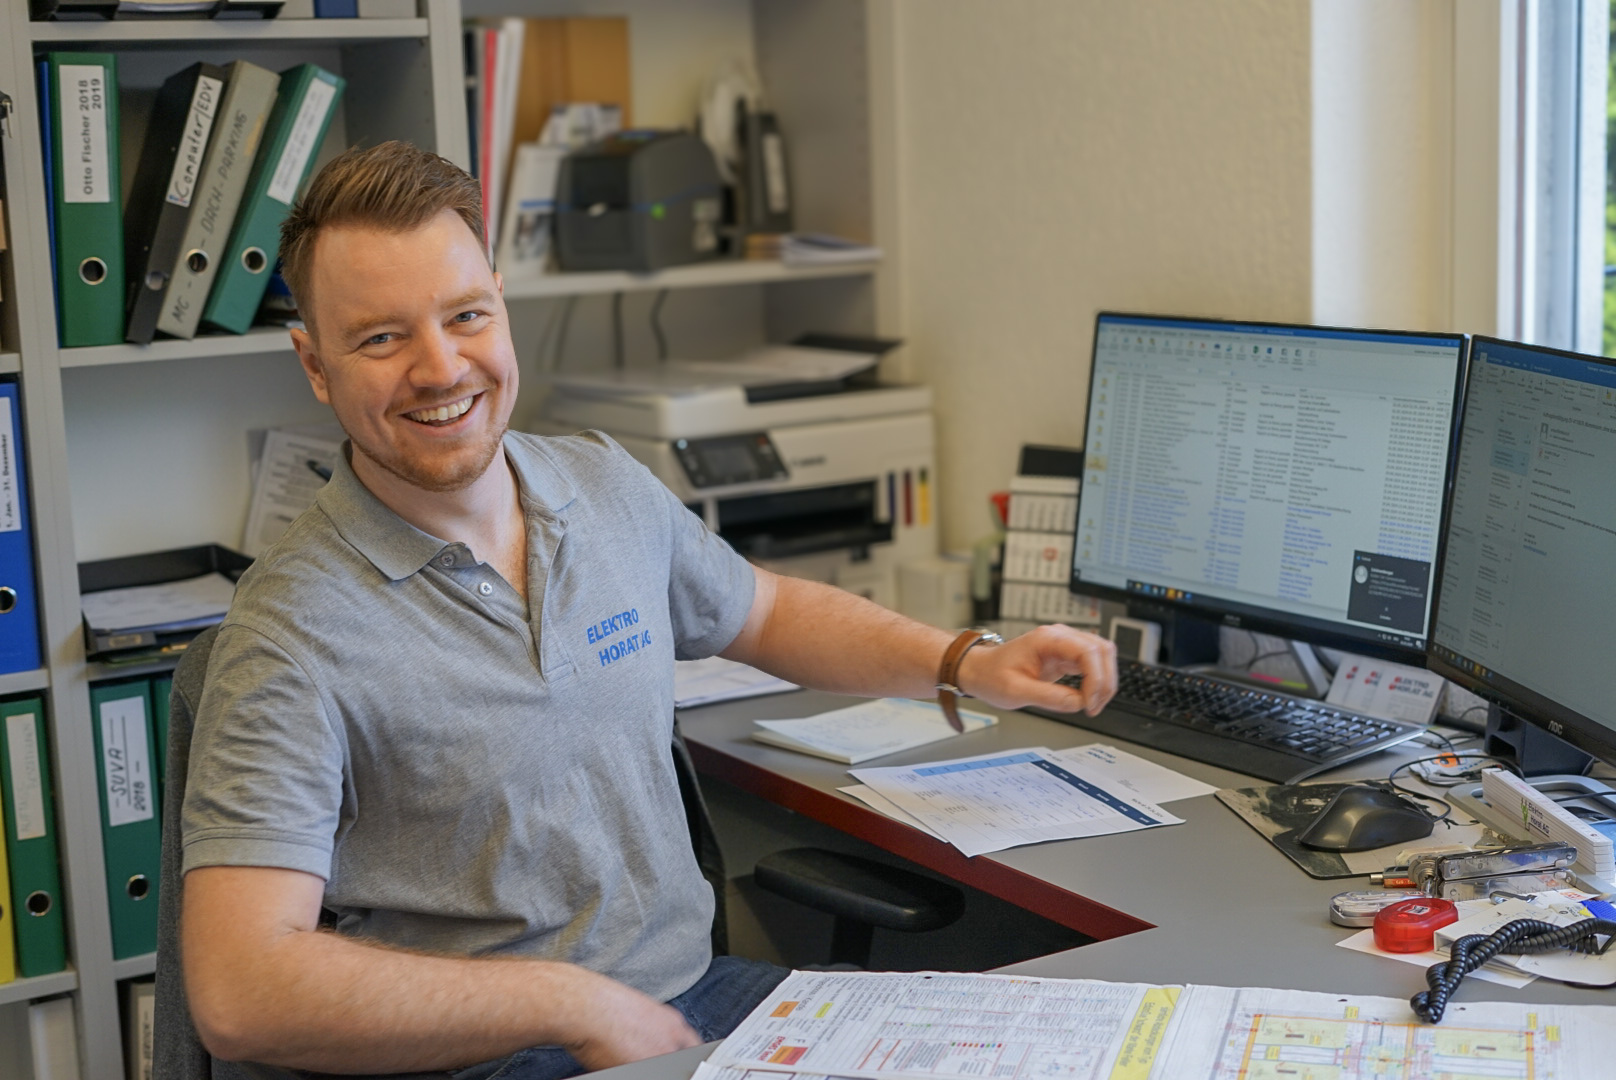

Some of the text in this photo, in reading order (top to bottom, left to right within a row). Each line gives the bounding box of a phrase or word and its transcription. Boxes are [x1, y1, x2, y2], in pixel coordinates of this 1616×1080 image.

[91, 78, 102, 109] 2019
[78, 79, 93, 195] Otto Fischer 2018
[586, 608, 639, 645] ELEKTRO
[598, 634, 639, 667] HORAT
[1548, 720, 1563, 735] AOC
[108, 747, 127, 797] SUVA
